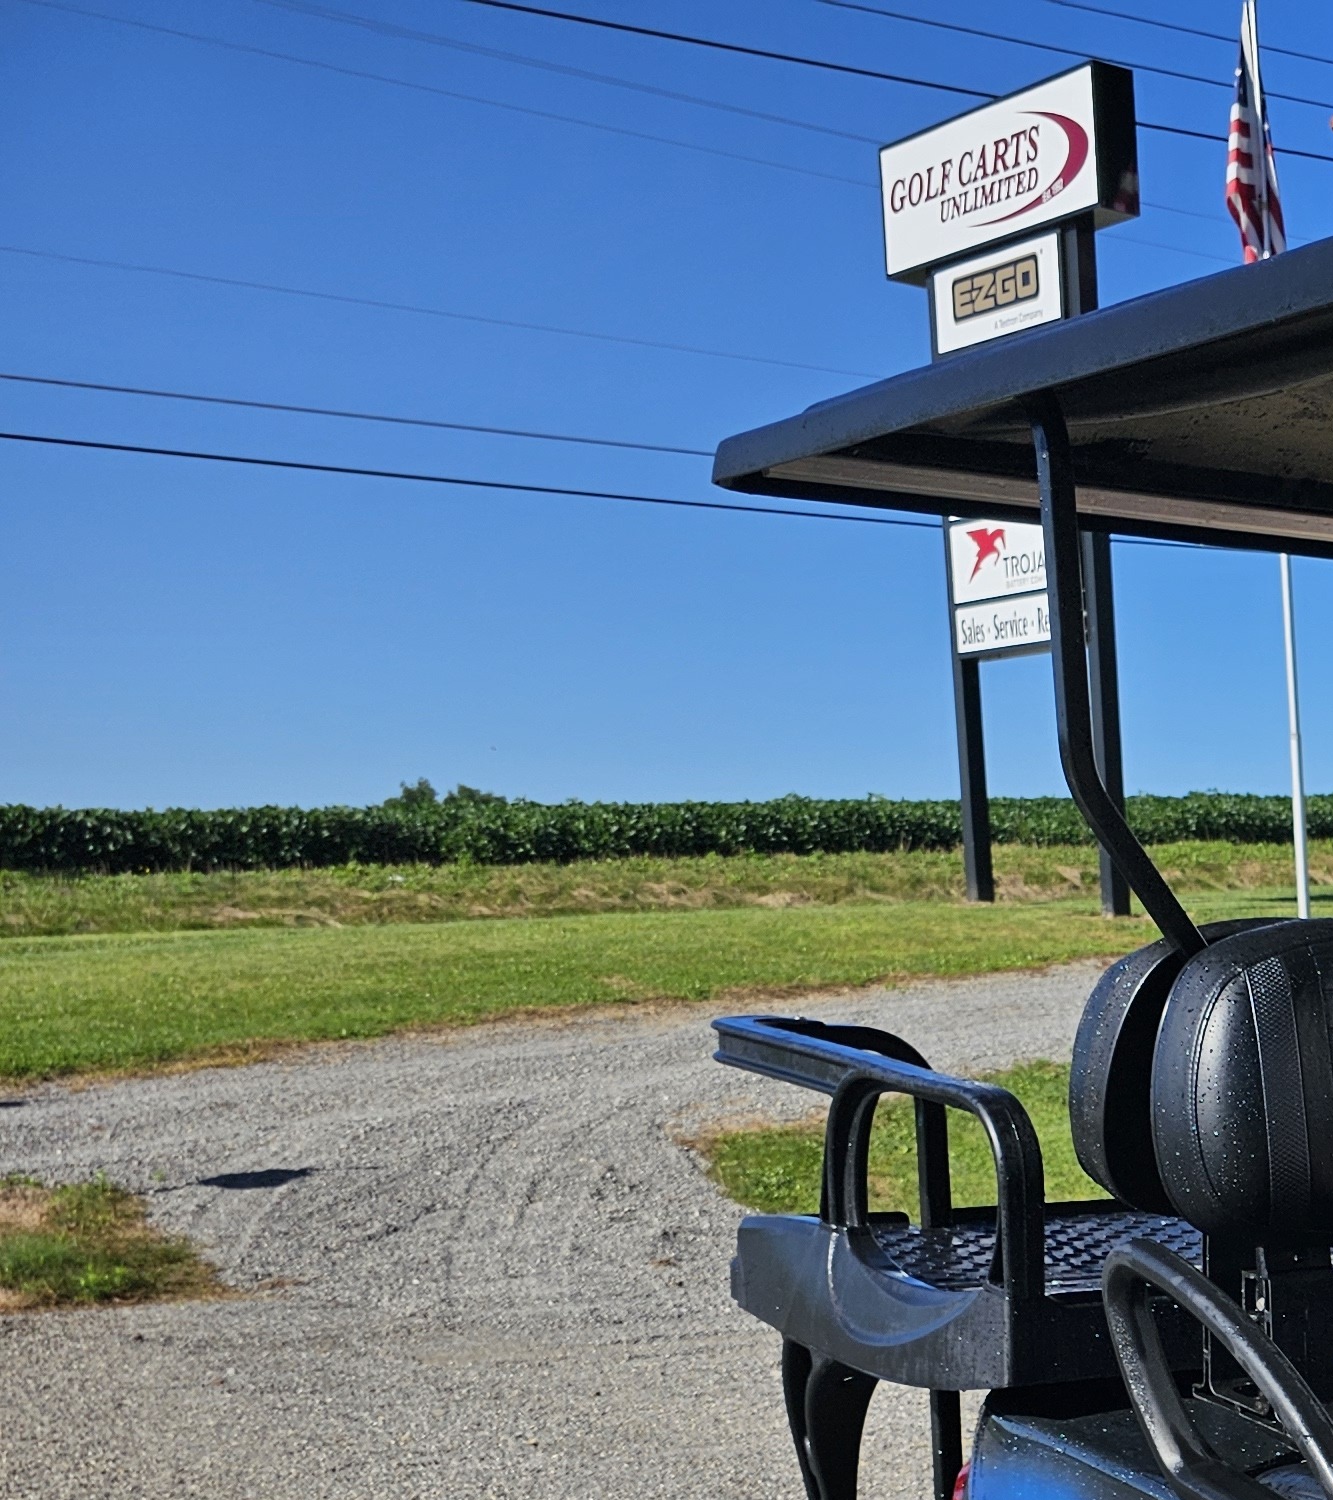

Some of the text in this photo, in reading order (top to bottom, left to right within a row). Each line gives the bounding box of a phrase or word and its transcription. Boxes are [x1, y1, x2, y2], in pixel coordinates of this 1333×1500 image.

[890, 124, 1040, 214] GOLF CARTS
[940, 167, 1039, 222] UNLIMITED
[962, 617, 985, 645] Sales
[993, 611, 1028, 640] Service
